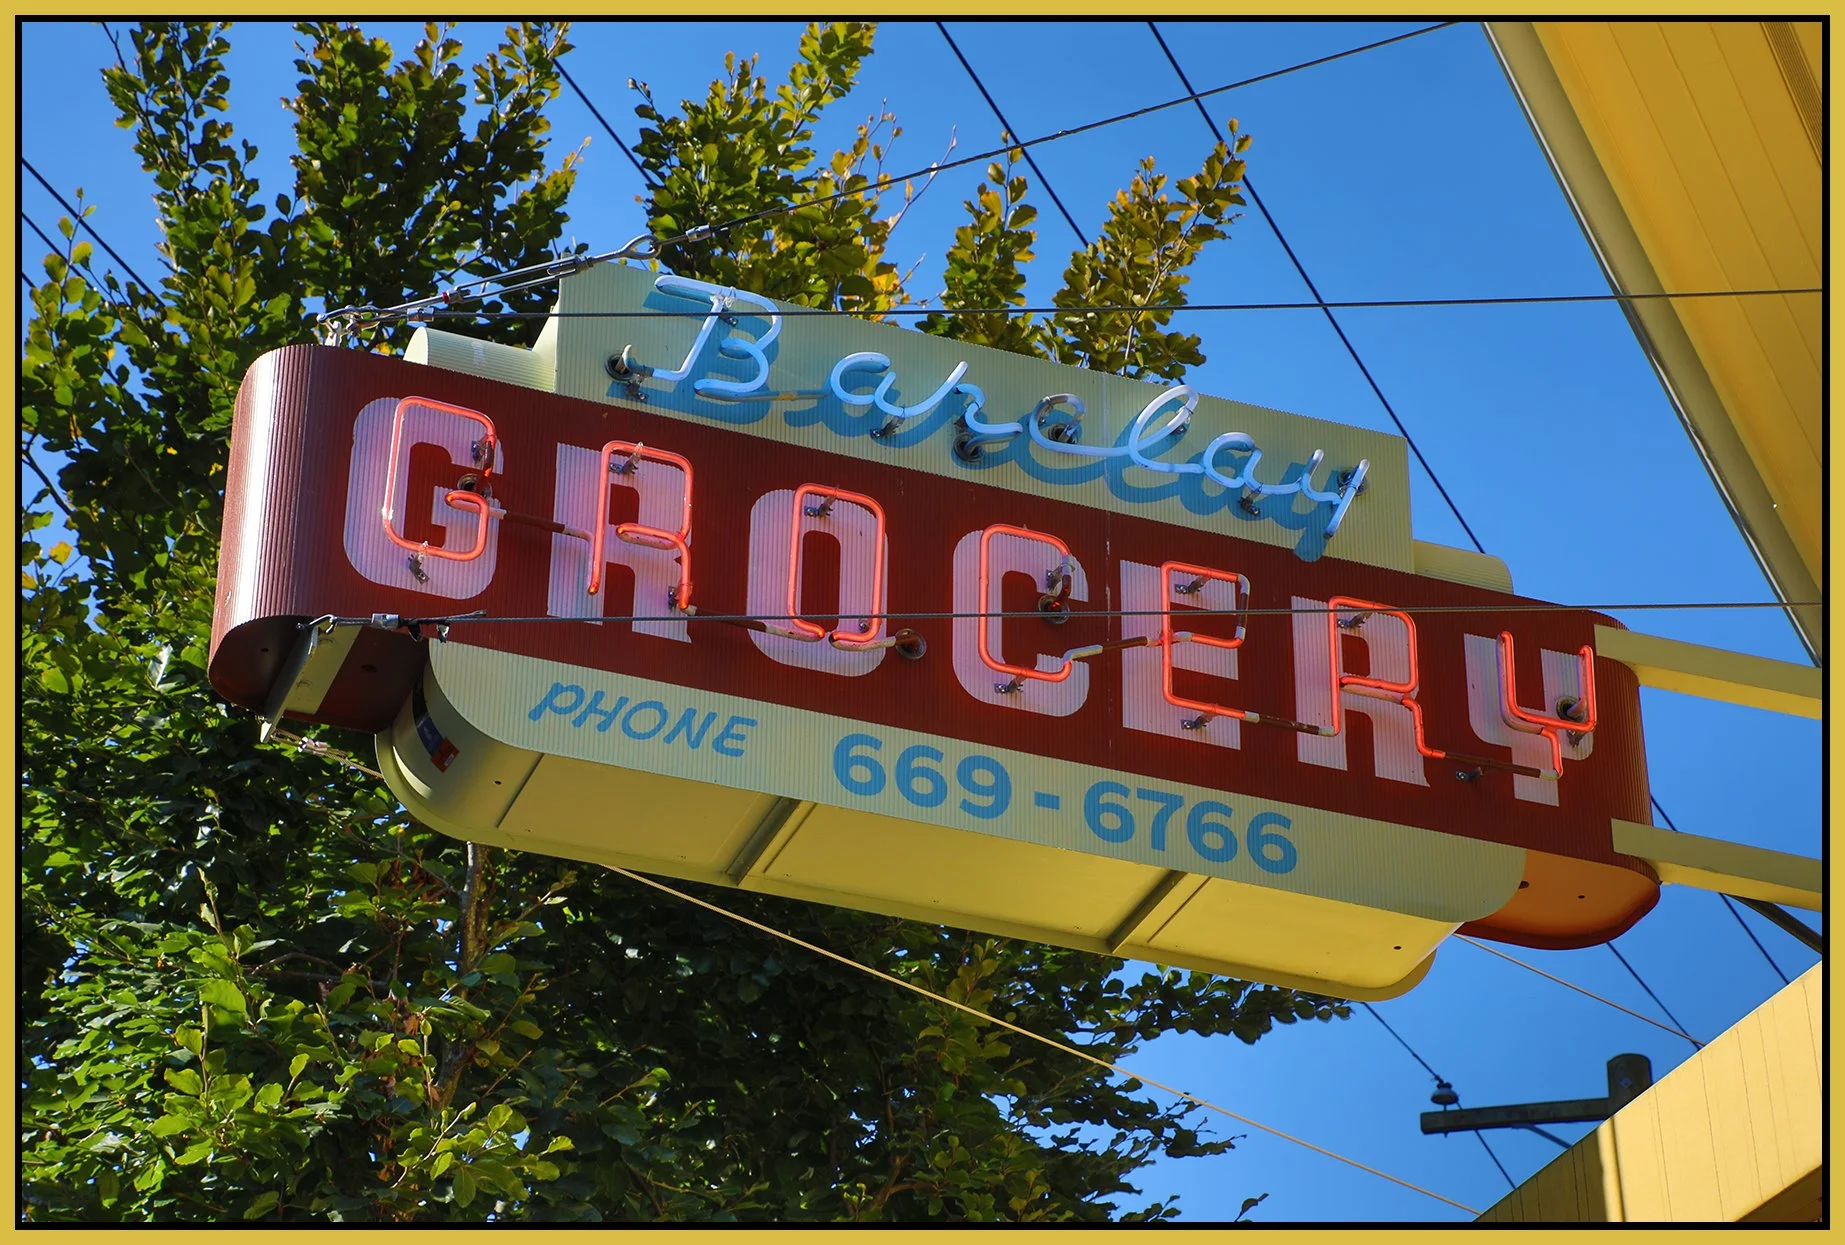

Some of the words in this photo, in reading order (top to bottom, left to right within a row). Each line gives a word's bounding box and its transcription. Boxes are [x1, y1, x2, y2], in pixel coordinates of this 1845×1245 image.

[602, 275, 1371, 560] Barclay
[343, 396, 1597, 807] GROCERY
[528, 682, 758, 757] PHONE
